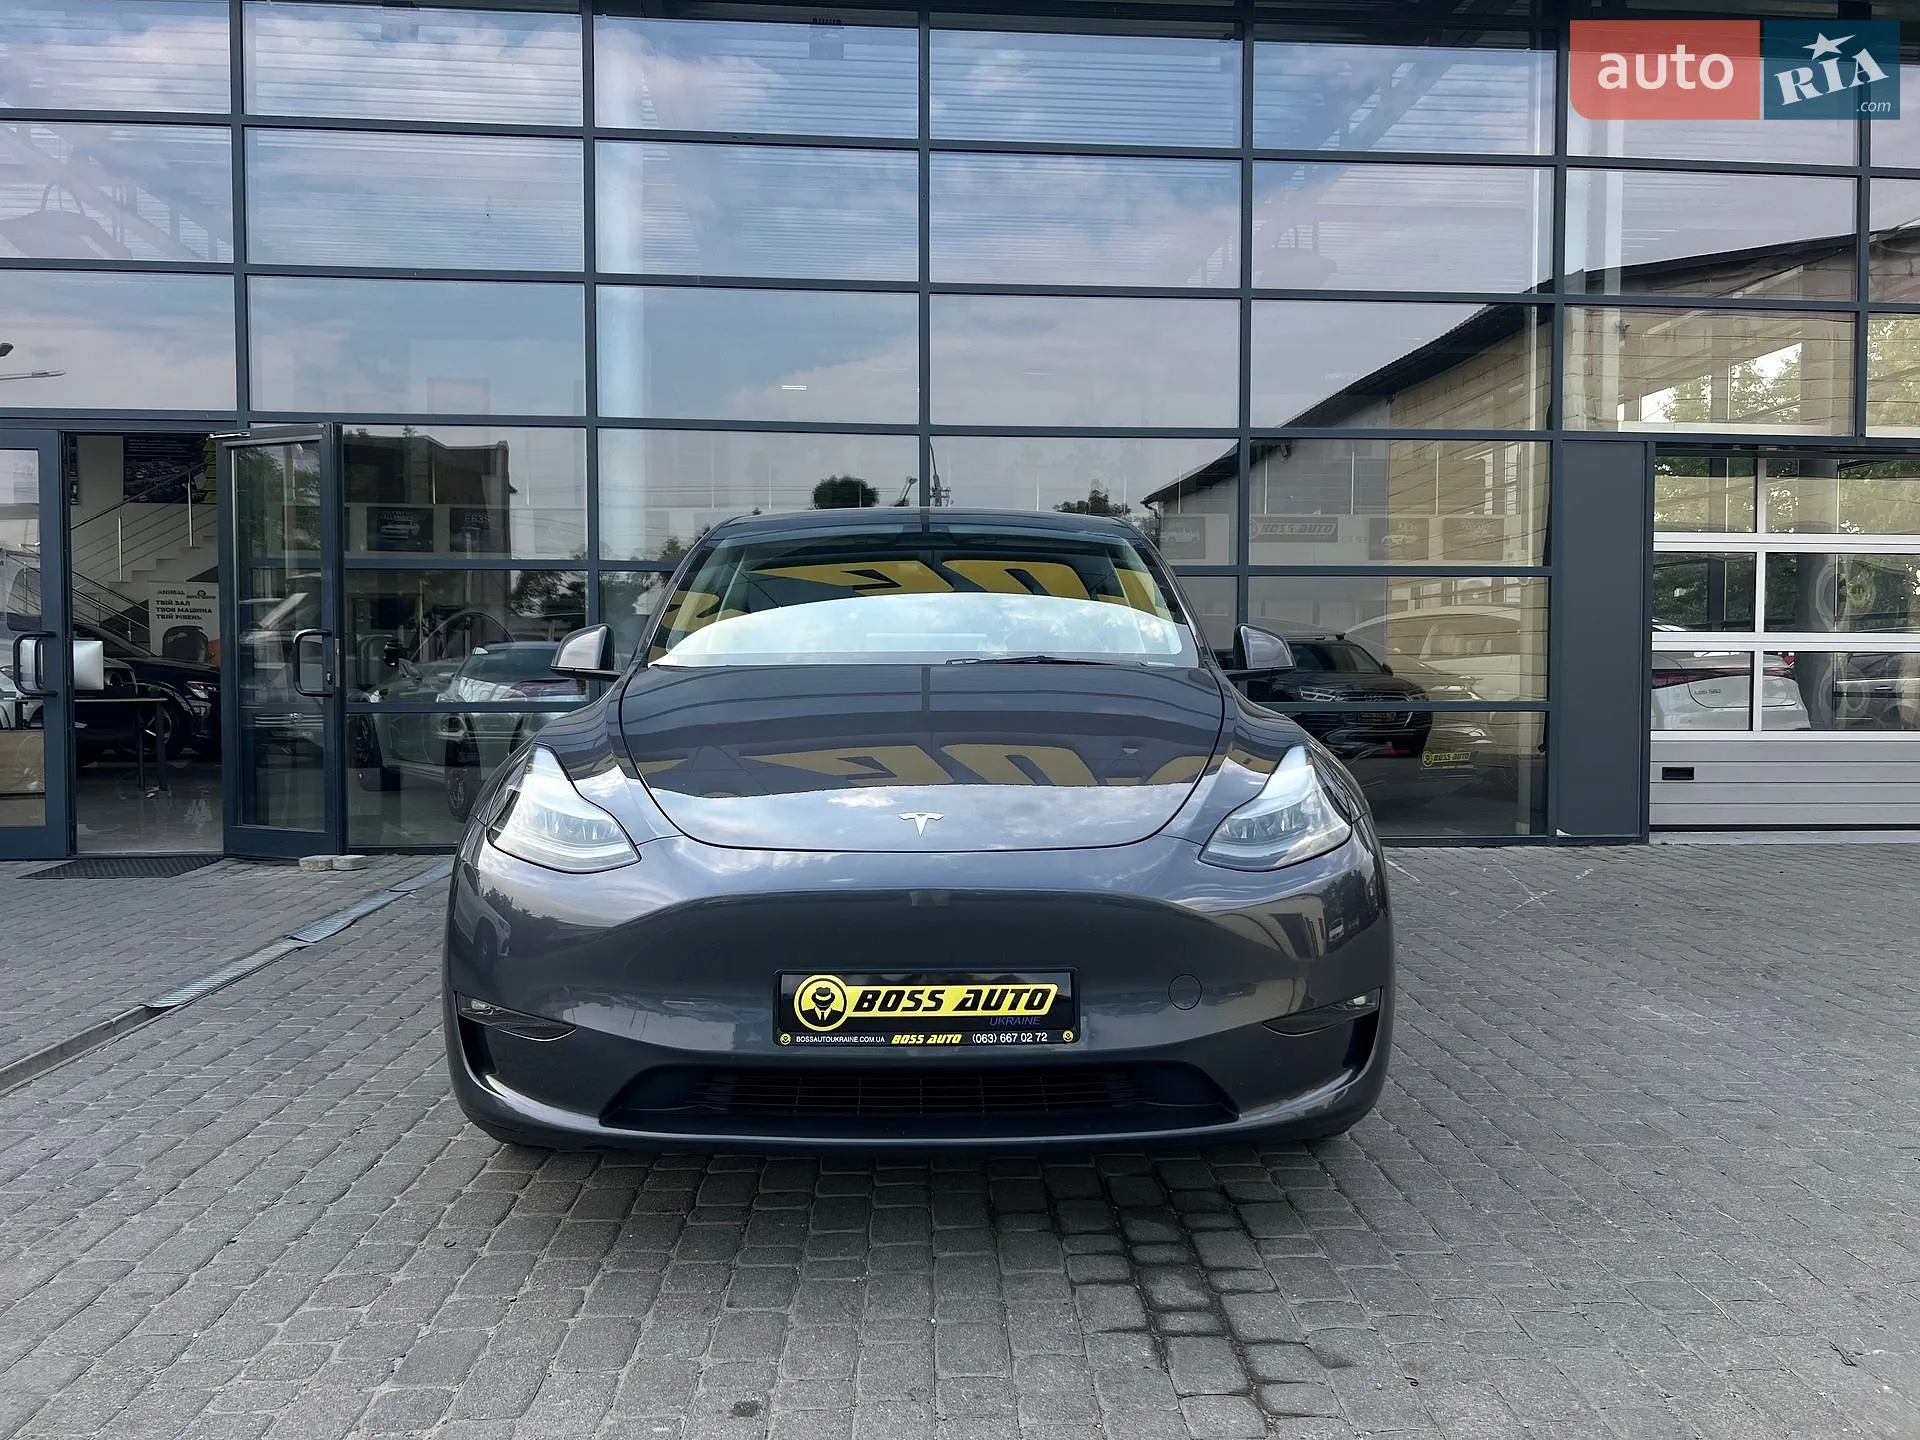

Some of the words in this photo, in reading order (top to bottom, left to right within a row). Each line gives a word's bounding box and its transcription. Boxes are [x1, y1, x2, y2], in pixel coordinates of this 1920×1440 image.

[852, 989, 946, 1012] BOSS
[953, 988, 1051, 1011] AUTO
[989, 1016, 1041, 1026] UKRAINE
[796, 1034, 885, 1043] BOSSAUTOUKRAINE.COM.UA
[891, 1034, 925, 1044] BOSS
[926, 1033, 962, 1044] AUTO
[972, 1032, 997, 1044] (063)
[1000, 1033, 1019, 1043] 667
[1020, 1033, 1033, 1043] 02
[1035, 1033, 1048, 1042] 72
